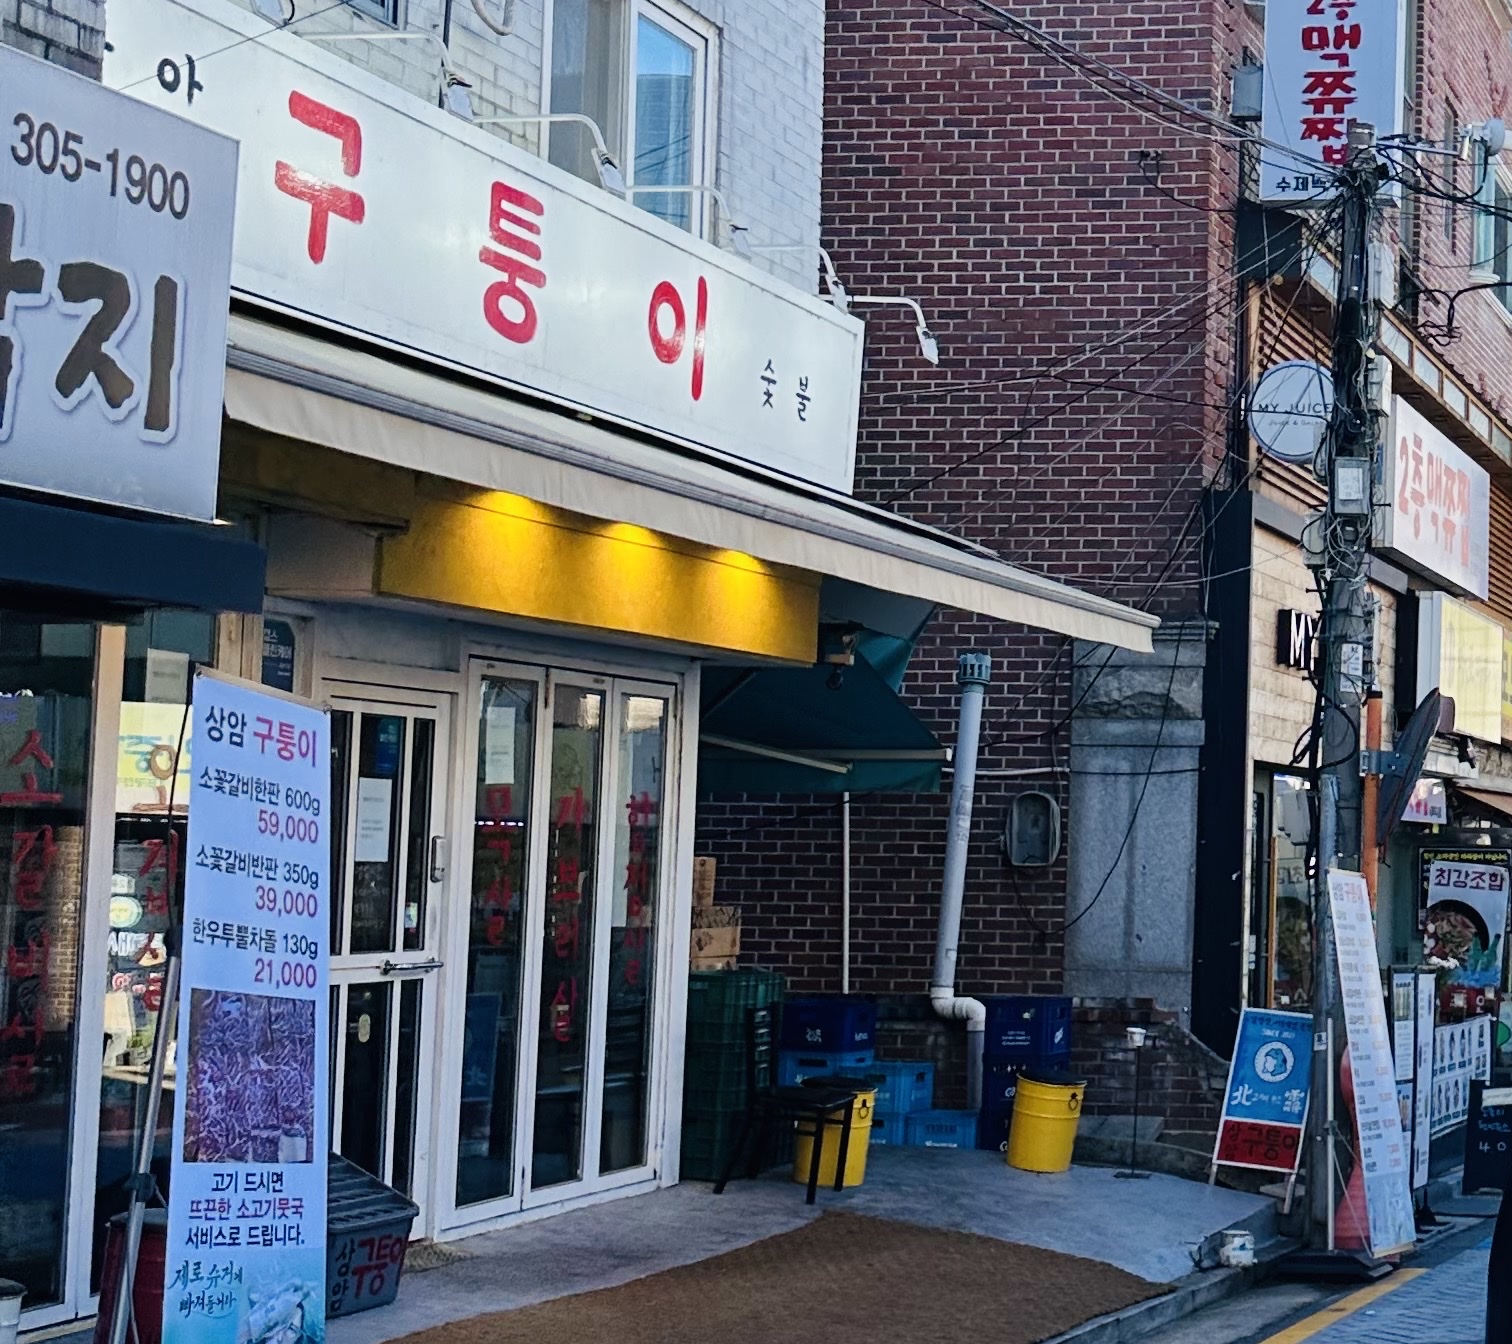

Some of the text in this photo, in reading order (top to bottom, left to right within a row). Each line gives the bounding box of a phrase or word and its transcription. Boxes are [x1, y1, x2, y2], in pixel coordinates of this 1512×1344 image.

[10, 112, 191, 220] 305-1900
[0, 203, 179, 432] 지
[1258, 402, 1333, 415] MY JUICE
[1399, 432, 1427, 541] 2층
[204, 704, 317, 769] 상암 구퉁이
[198, 765, 321, 816] 소꽃갈비한판 600g
[257, 809, 319, 844] 59,000
[195, 843, 320, 891] 소꽃갈비반판 350g
[1434, 867, 1506, 892] 최강조합
[255, 885, 318, 918] 39,000
[282, 932, 319, 960] 130g
[254, 958, 317, 990] 21,000
[1230, 1083, 1253, 1107] 北
[211, 1170, 284, 1193] 고기 드시면
[188, 1197, 231, 1221] 뜨끈한
[185, 1223, 306, 1250] 서비스로 드립니다.
